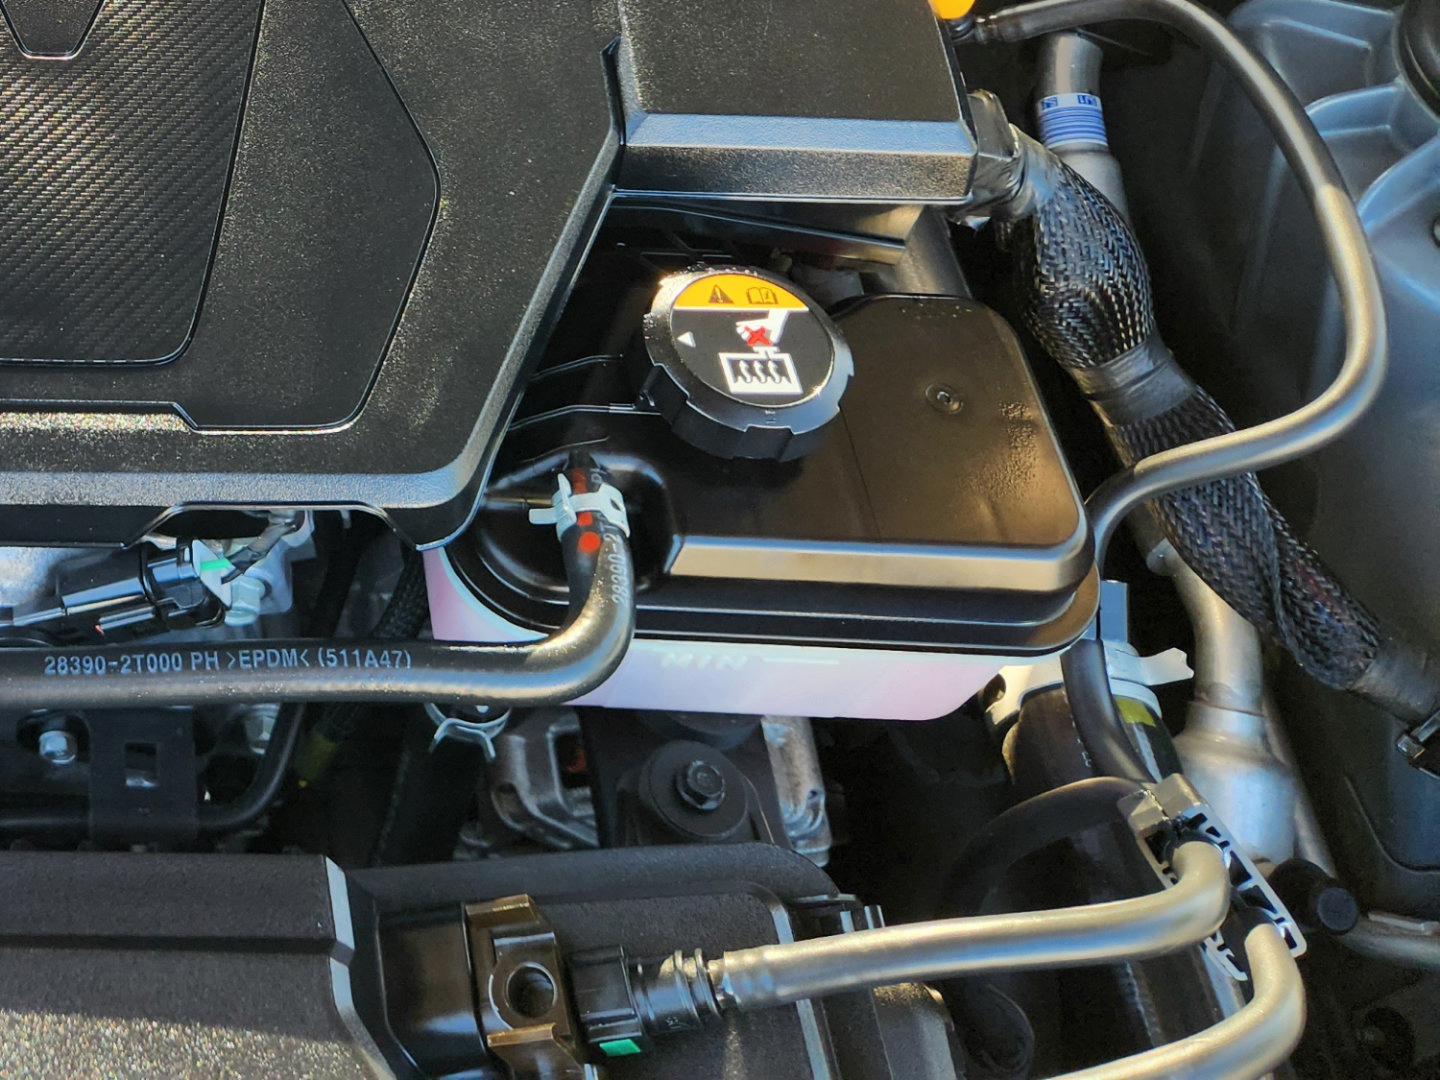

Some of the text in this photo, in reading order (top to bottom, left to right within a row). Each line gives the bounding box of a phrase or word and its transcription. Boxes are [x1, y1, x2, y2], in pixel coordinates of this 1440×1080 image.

[44, 647, 411, 675] 28390-2T000 PH >EPDM< (511A47)
[661, 651, 748, 671] MIN
